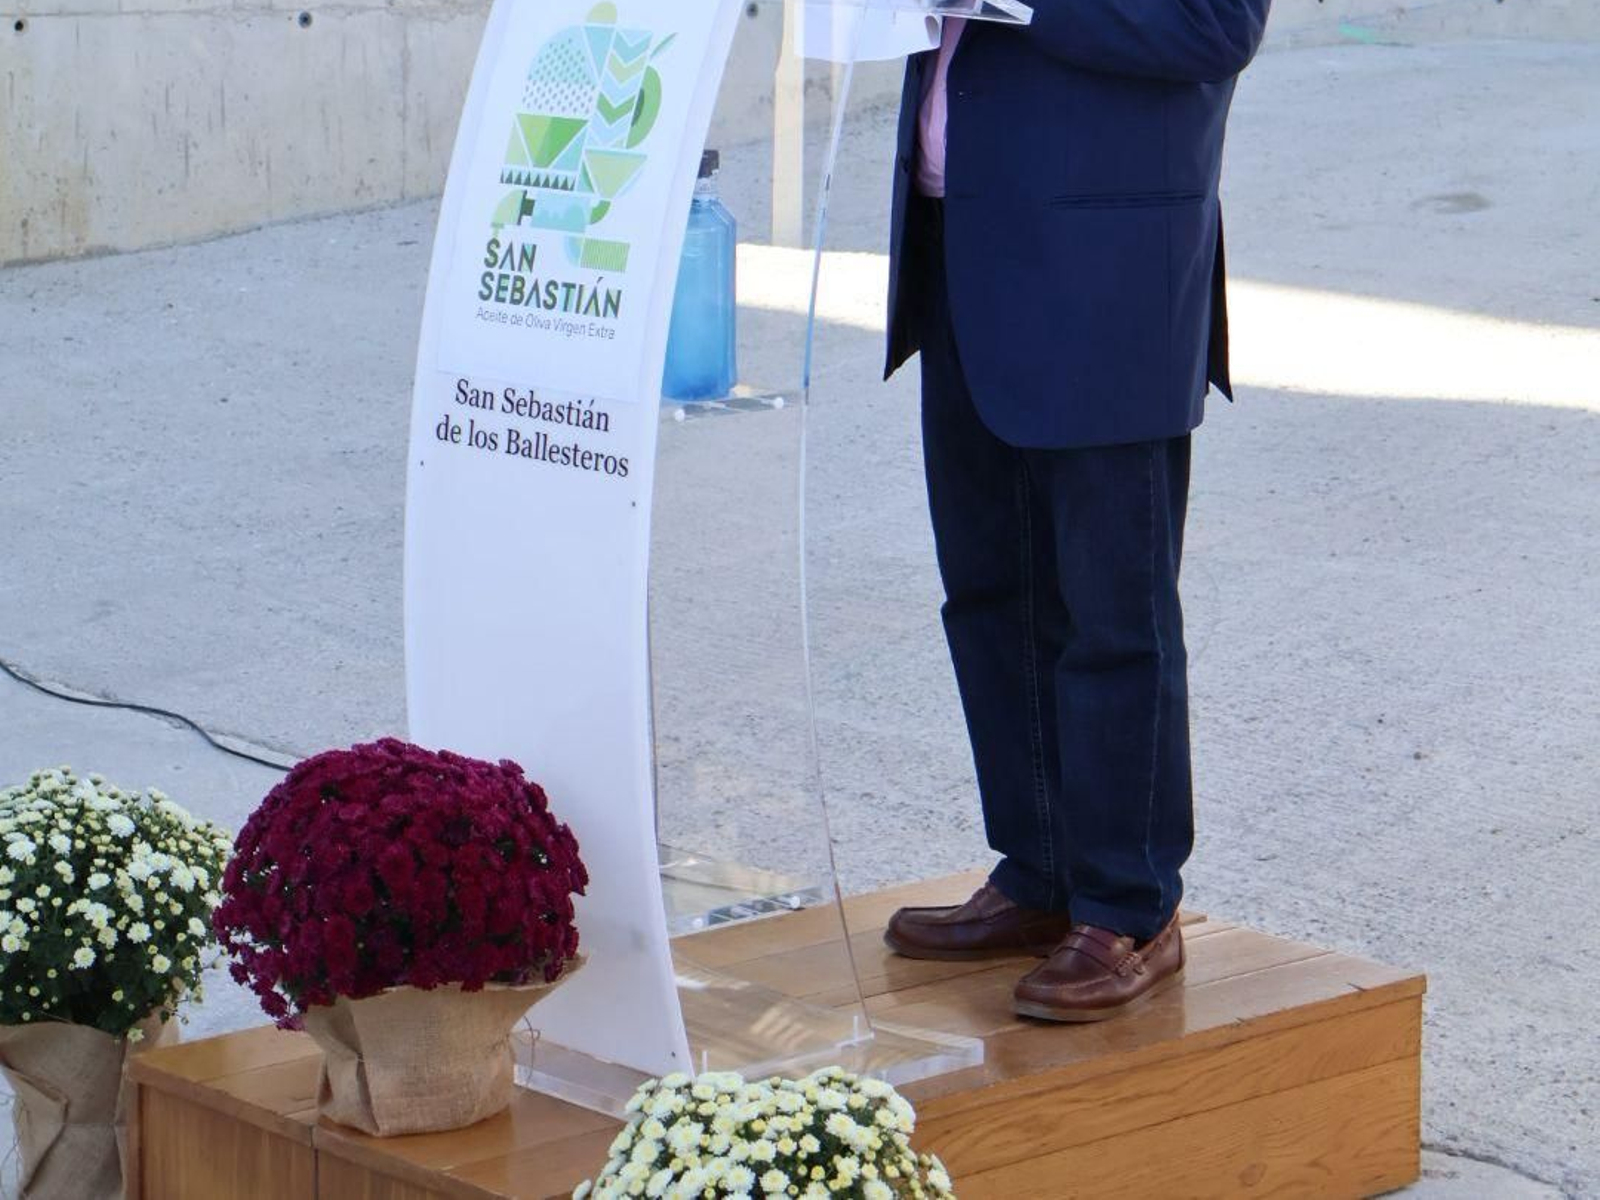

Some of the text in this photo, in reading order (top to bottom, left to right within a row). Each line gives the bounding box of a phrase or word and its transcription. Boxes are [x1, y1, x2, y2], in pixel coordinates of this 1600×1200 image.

[483, 237, 537, 273] SAN
[478, 270, 622, 319] SEBASTIÁN
[476, 306, 616, 340] Aceite de Oliva Virgen Extra
[455, 378, 609, 432] San Sebastián
[436, 414, 629, 478] de los Ballesteros
